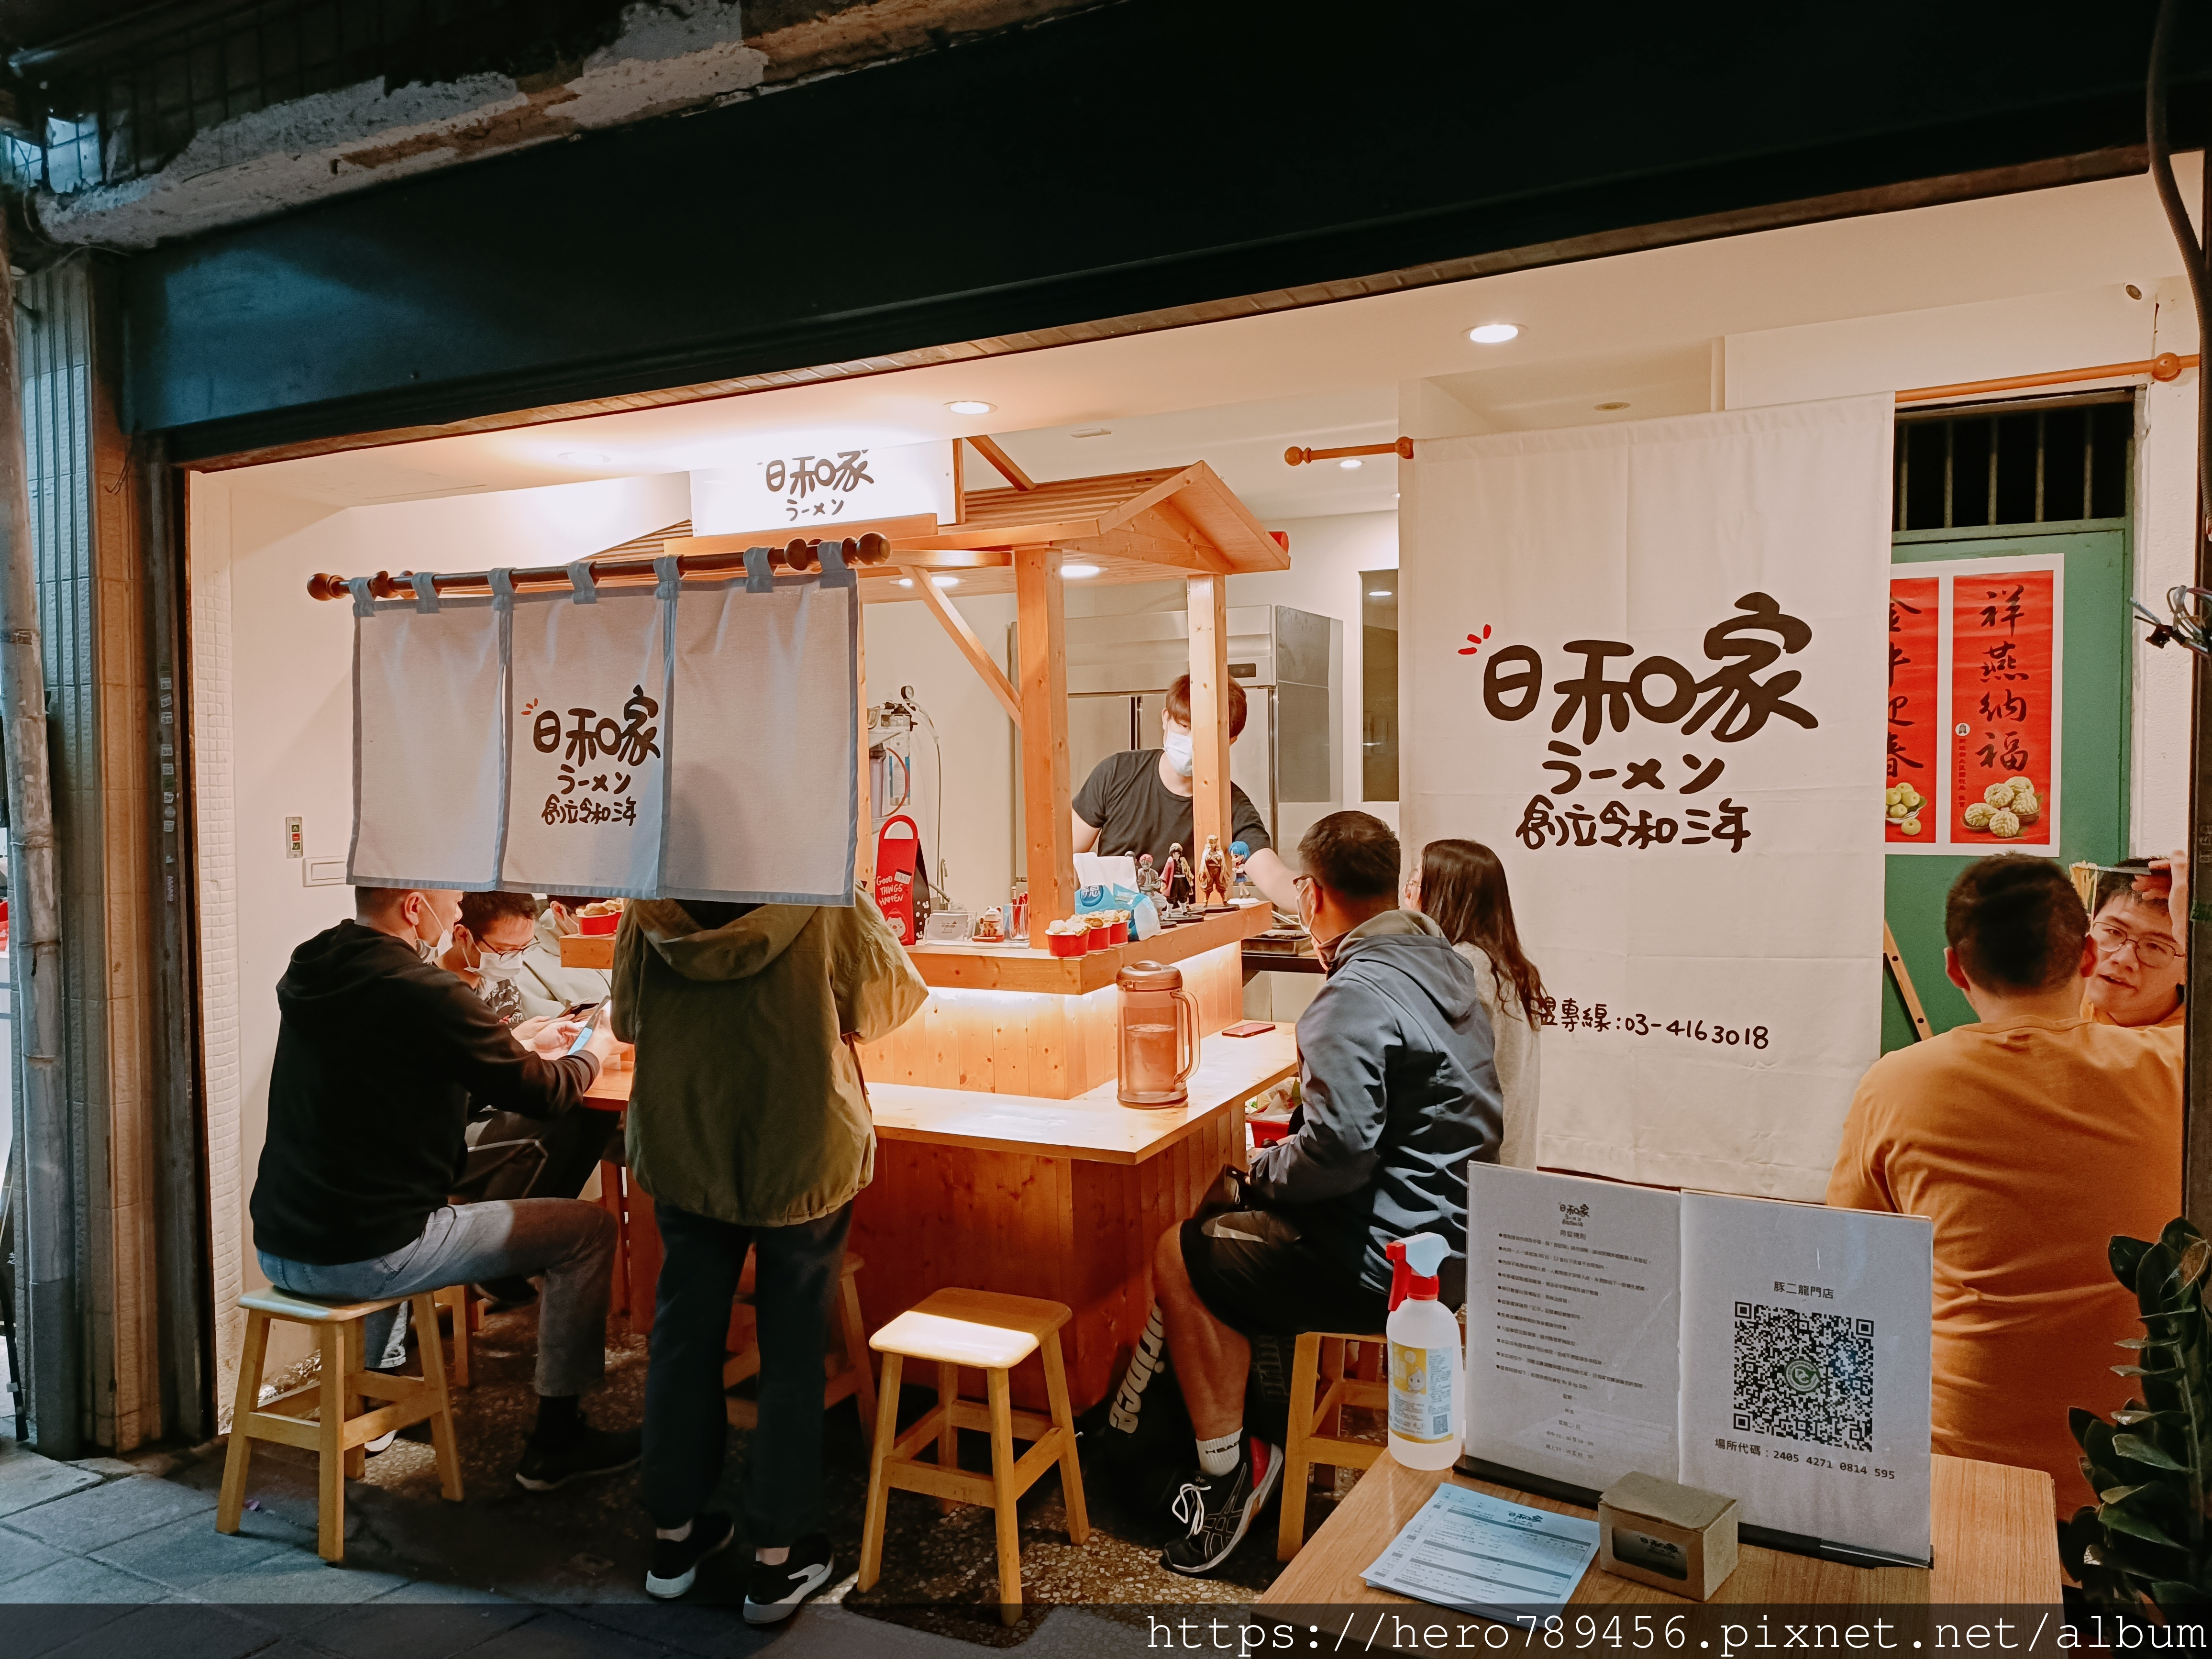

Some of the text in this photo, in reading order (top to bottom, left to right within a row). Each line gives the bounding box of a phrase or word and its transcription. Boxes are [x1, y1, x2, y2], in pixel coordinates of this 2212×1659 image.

[785, 499, 844, 521] ラーメン
[1483, 592, 1819, 745] 日和家
[533, 685, 661, 767] 日和家
[557, 764, 631, 795] ラーメン
[1542, 741, 1725, 795] ラーメン
[542, 794, 637, 826] 創立令和三年
[1516, 795, 1751, 853] 創立令和三年
[876, 875, 893, 886] GOOD
[879, 884, 903, 896] THINGS
[878, 894, 904, 907] HAPPEN
[1774, 1281, 1834, 1299] 豚二龍門店
[1806, 1457, 1833, 1469] 4271
[1840, 1462, 1867, 1474] 0814
[1875, 1468, 1895, 1479] 595
